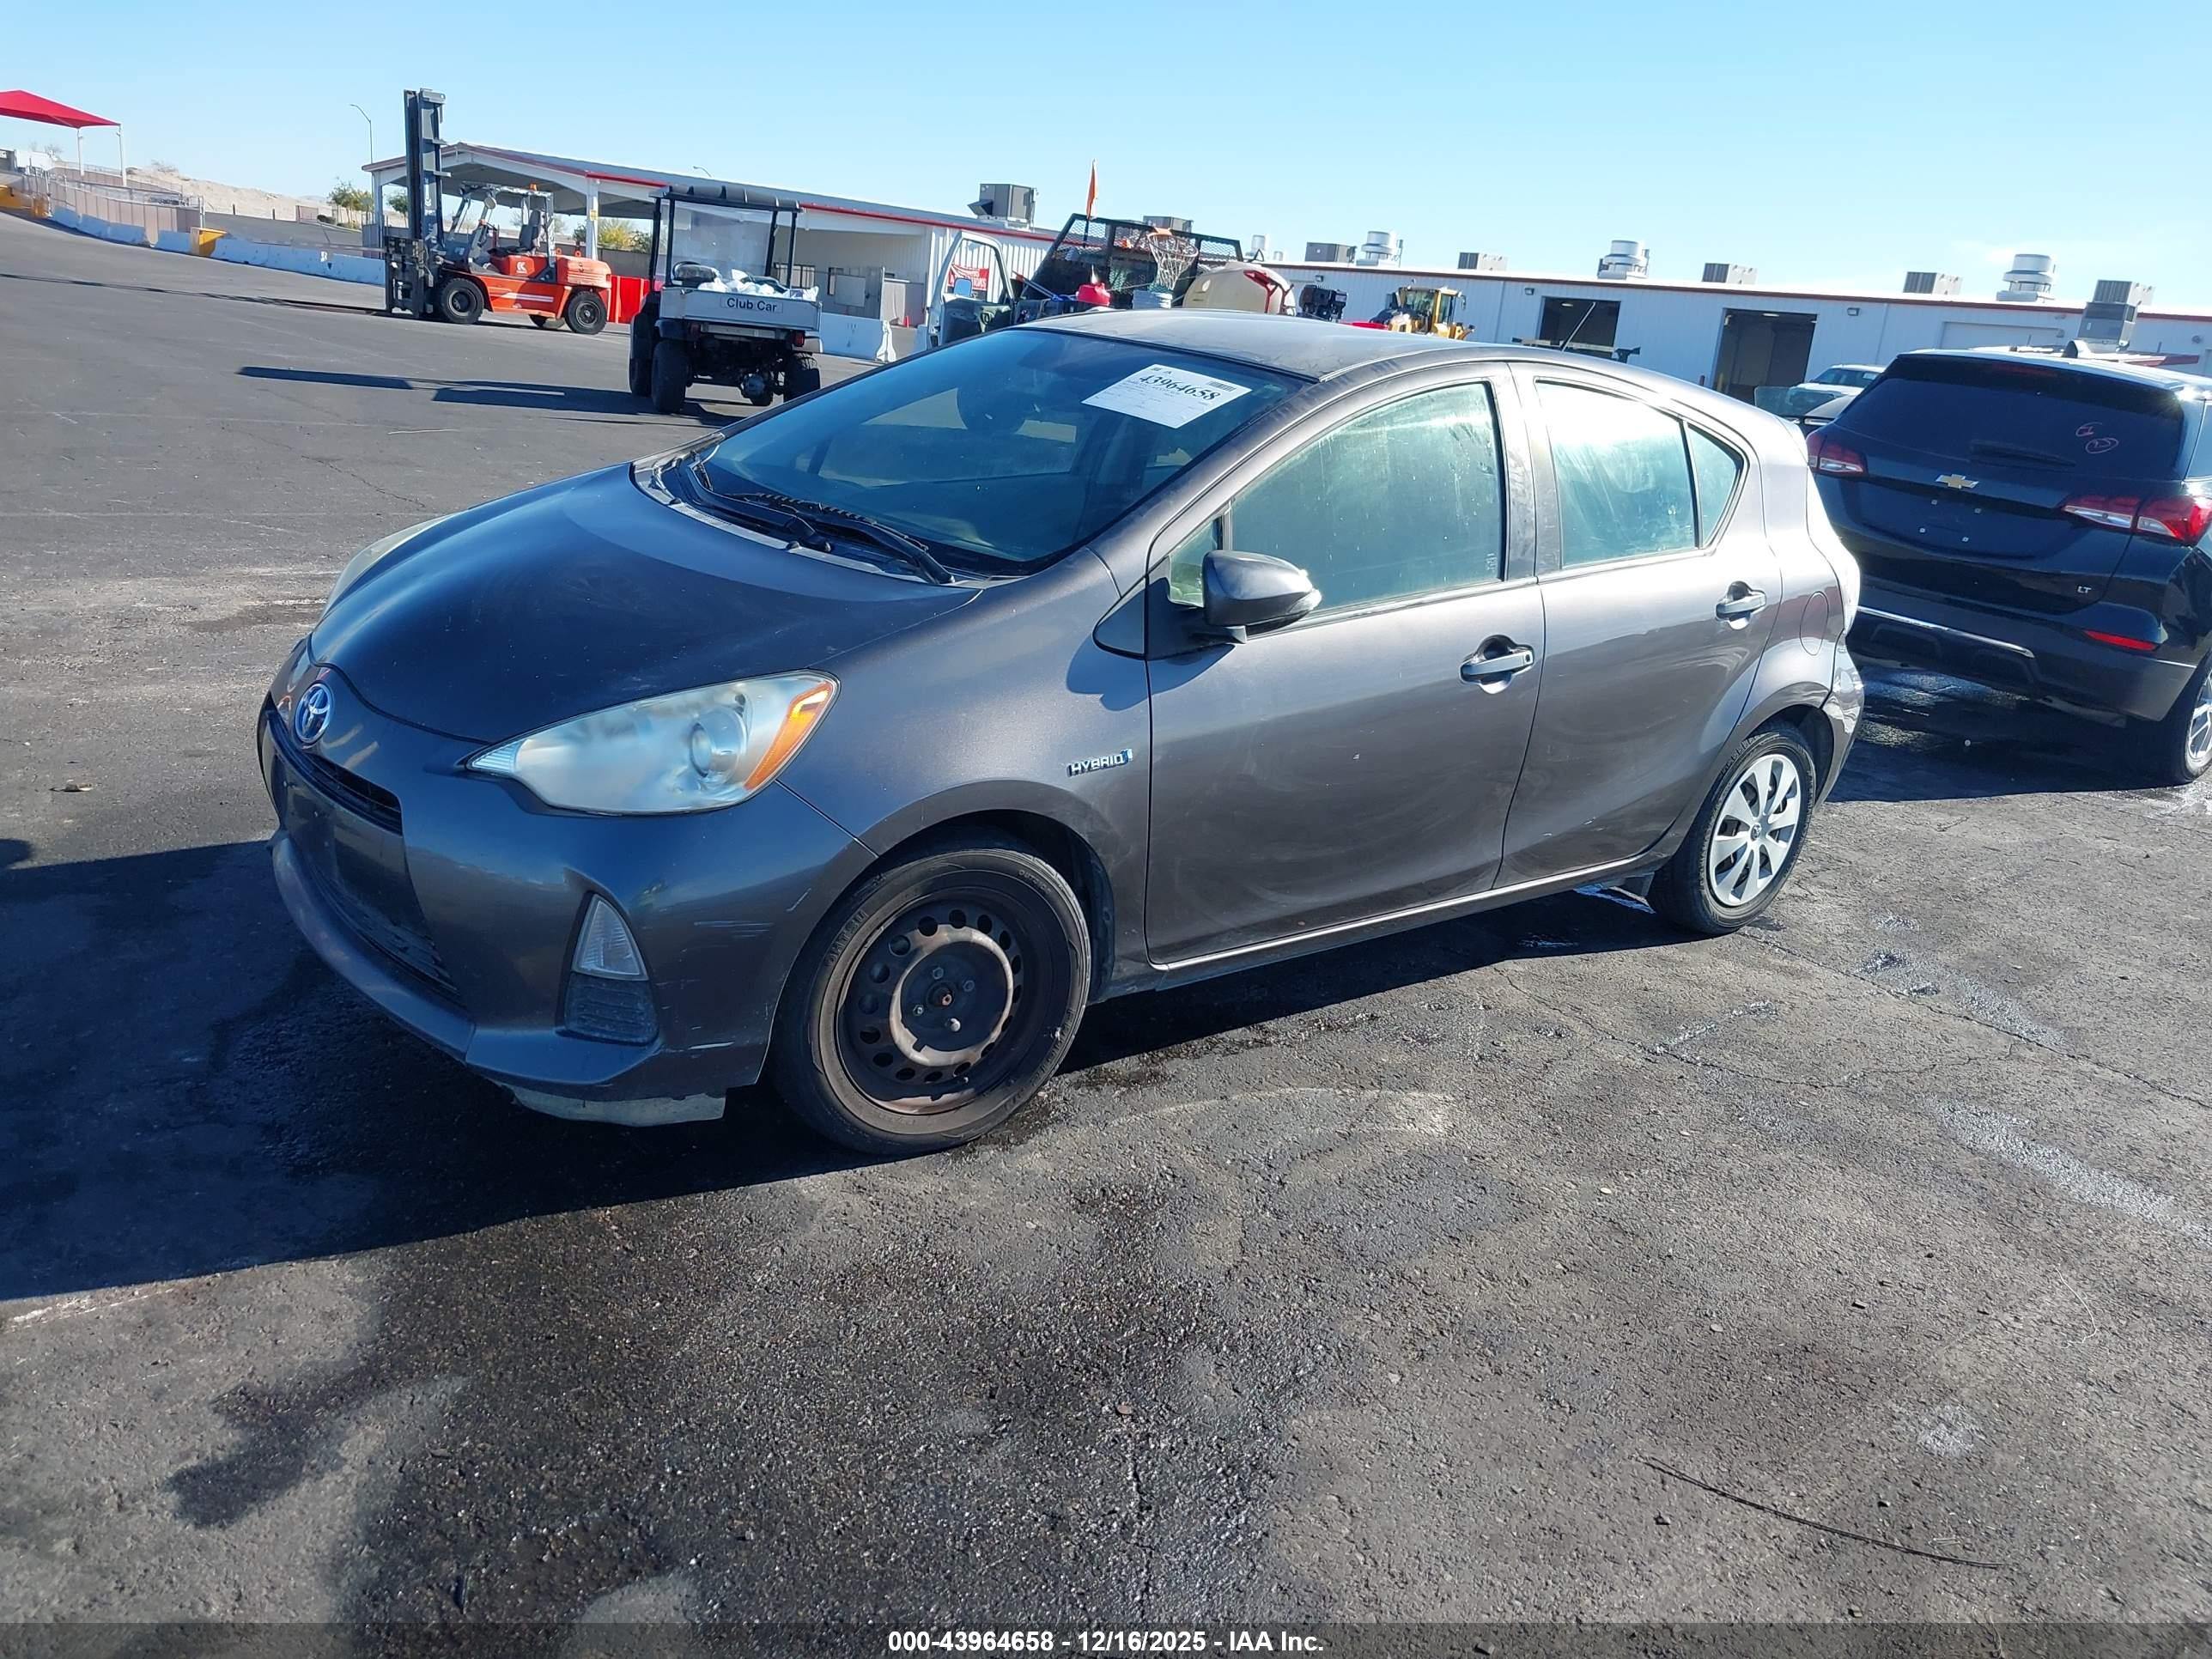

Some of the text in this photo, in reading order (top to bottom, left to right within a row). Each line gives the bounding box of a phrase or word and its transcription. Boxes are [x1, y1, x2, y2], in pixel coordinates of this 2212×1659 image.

[726, 297, 776, 313] Club Car
[1139, 375, 1220, 400] 43964658
[1069, 752, 1126, 775] HYBRID
